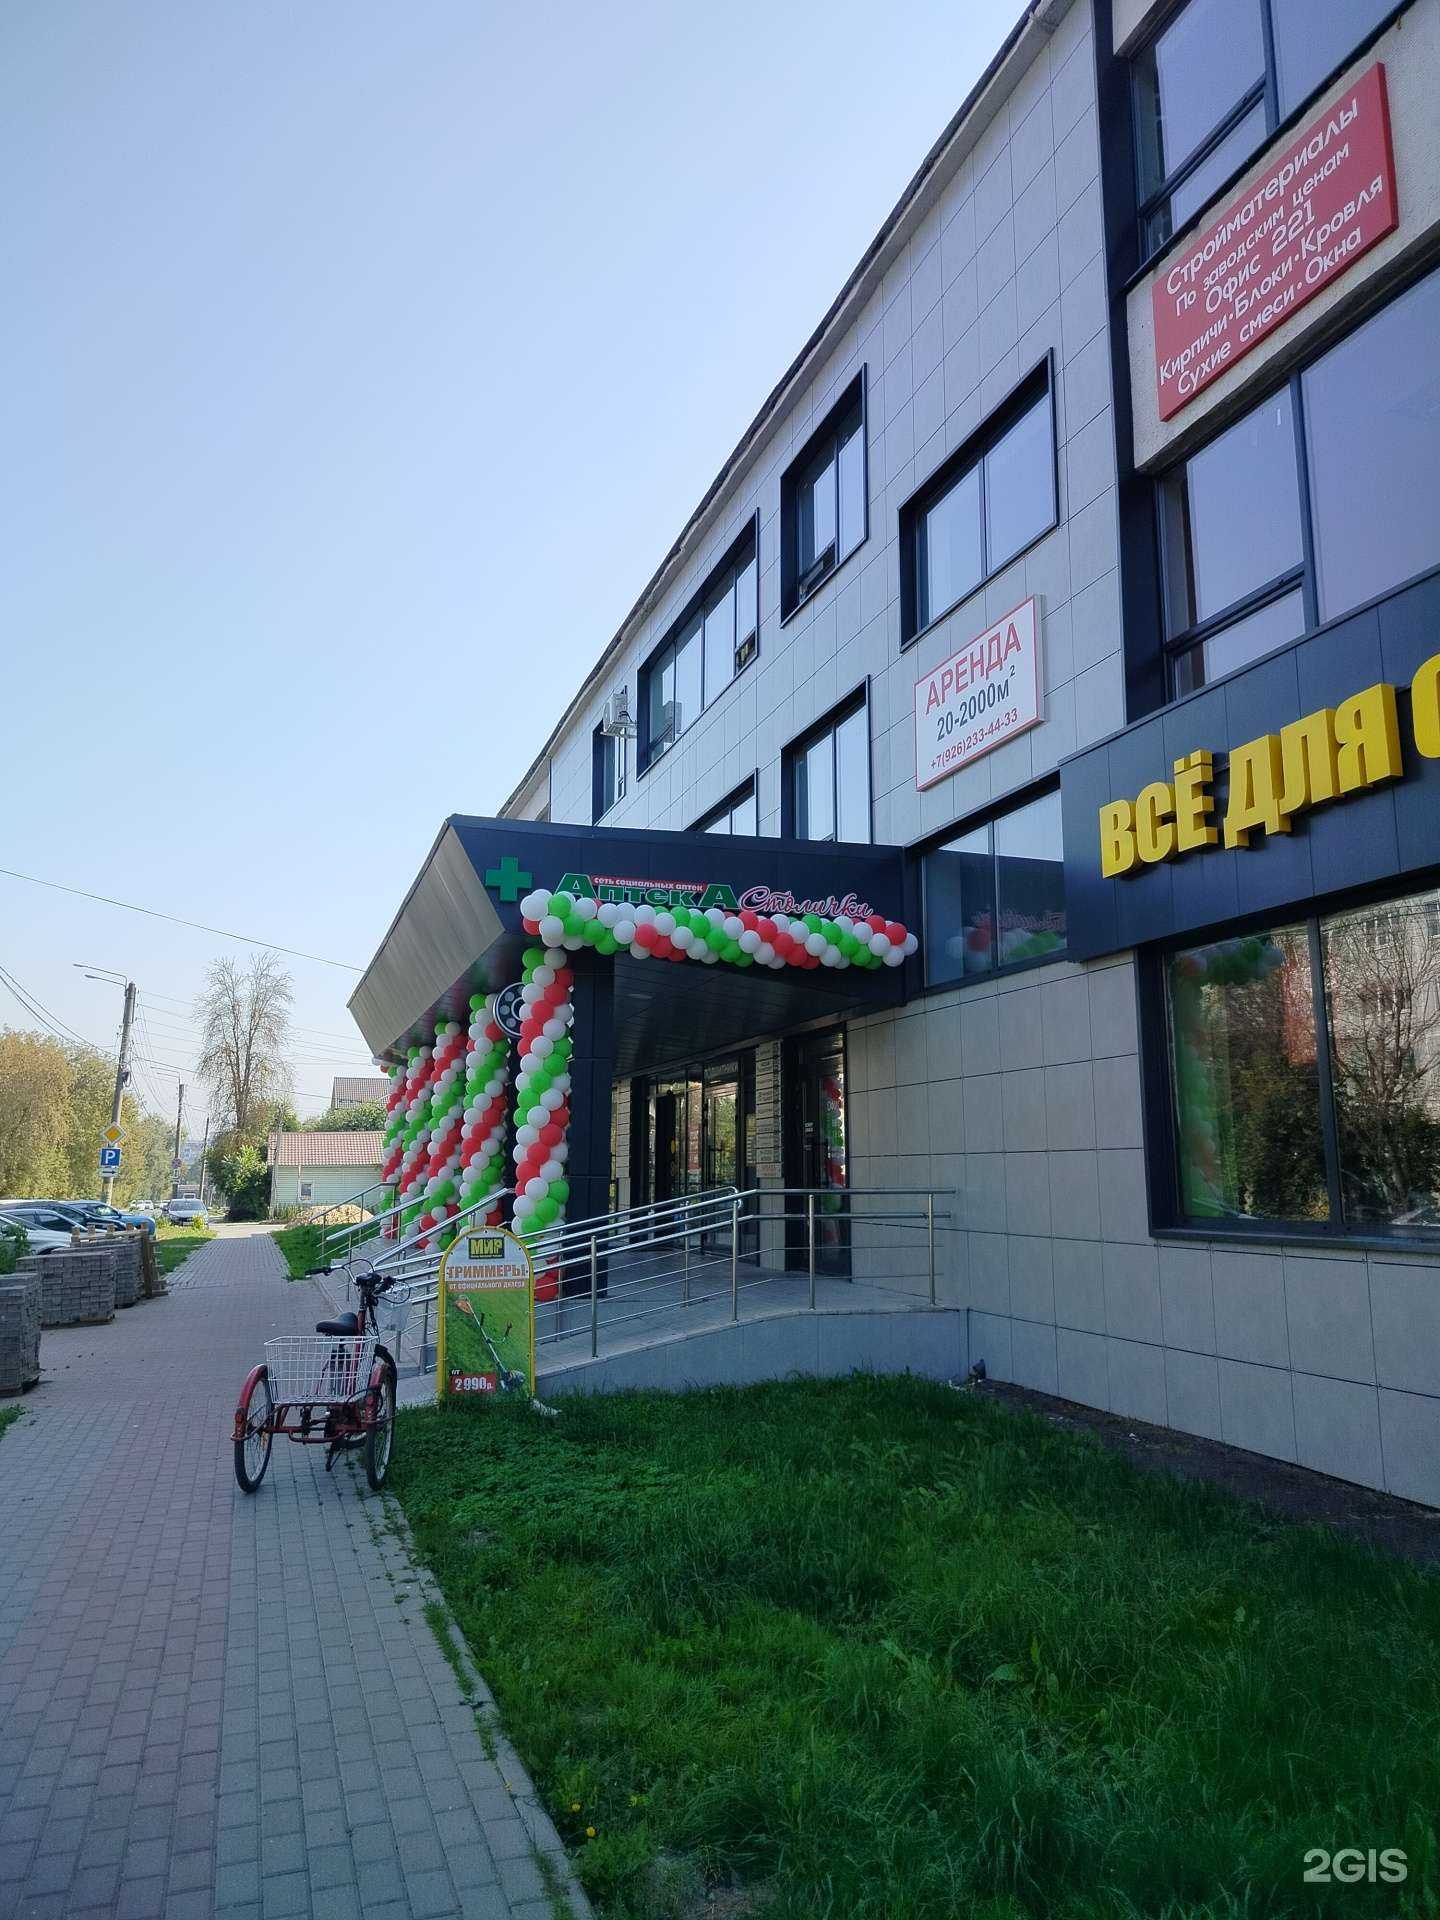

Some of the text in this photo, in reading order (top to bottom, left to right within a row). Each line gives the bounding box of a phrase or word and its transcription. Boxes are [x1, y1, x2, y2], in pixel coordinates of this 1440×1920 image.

[1166, 98, 1358, 295] Стройматериалы
[1175, 142, 1349, 317] По заводским ценам
[1205, 199, 1315, 314] Офис 221
[1177, 340, 1231, 395] Сухие
[925, 622, 1022, 715] АРЕНДА
[930, 708, 1018, 769] +7(926)233-44-33
[1099, 749, 1218, 878] ВСЁ
[1223, 683, 1403, 850] ДЛЯ
[615, 879, 674, 890] социальных
[739, 885, 874, 918] Столички
[106, 1150, 116, 1164] P
[447, 1264, 526, 1278] ТРИММЕРЫ
[470, 1238, 503, 1255] МИР
